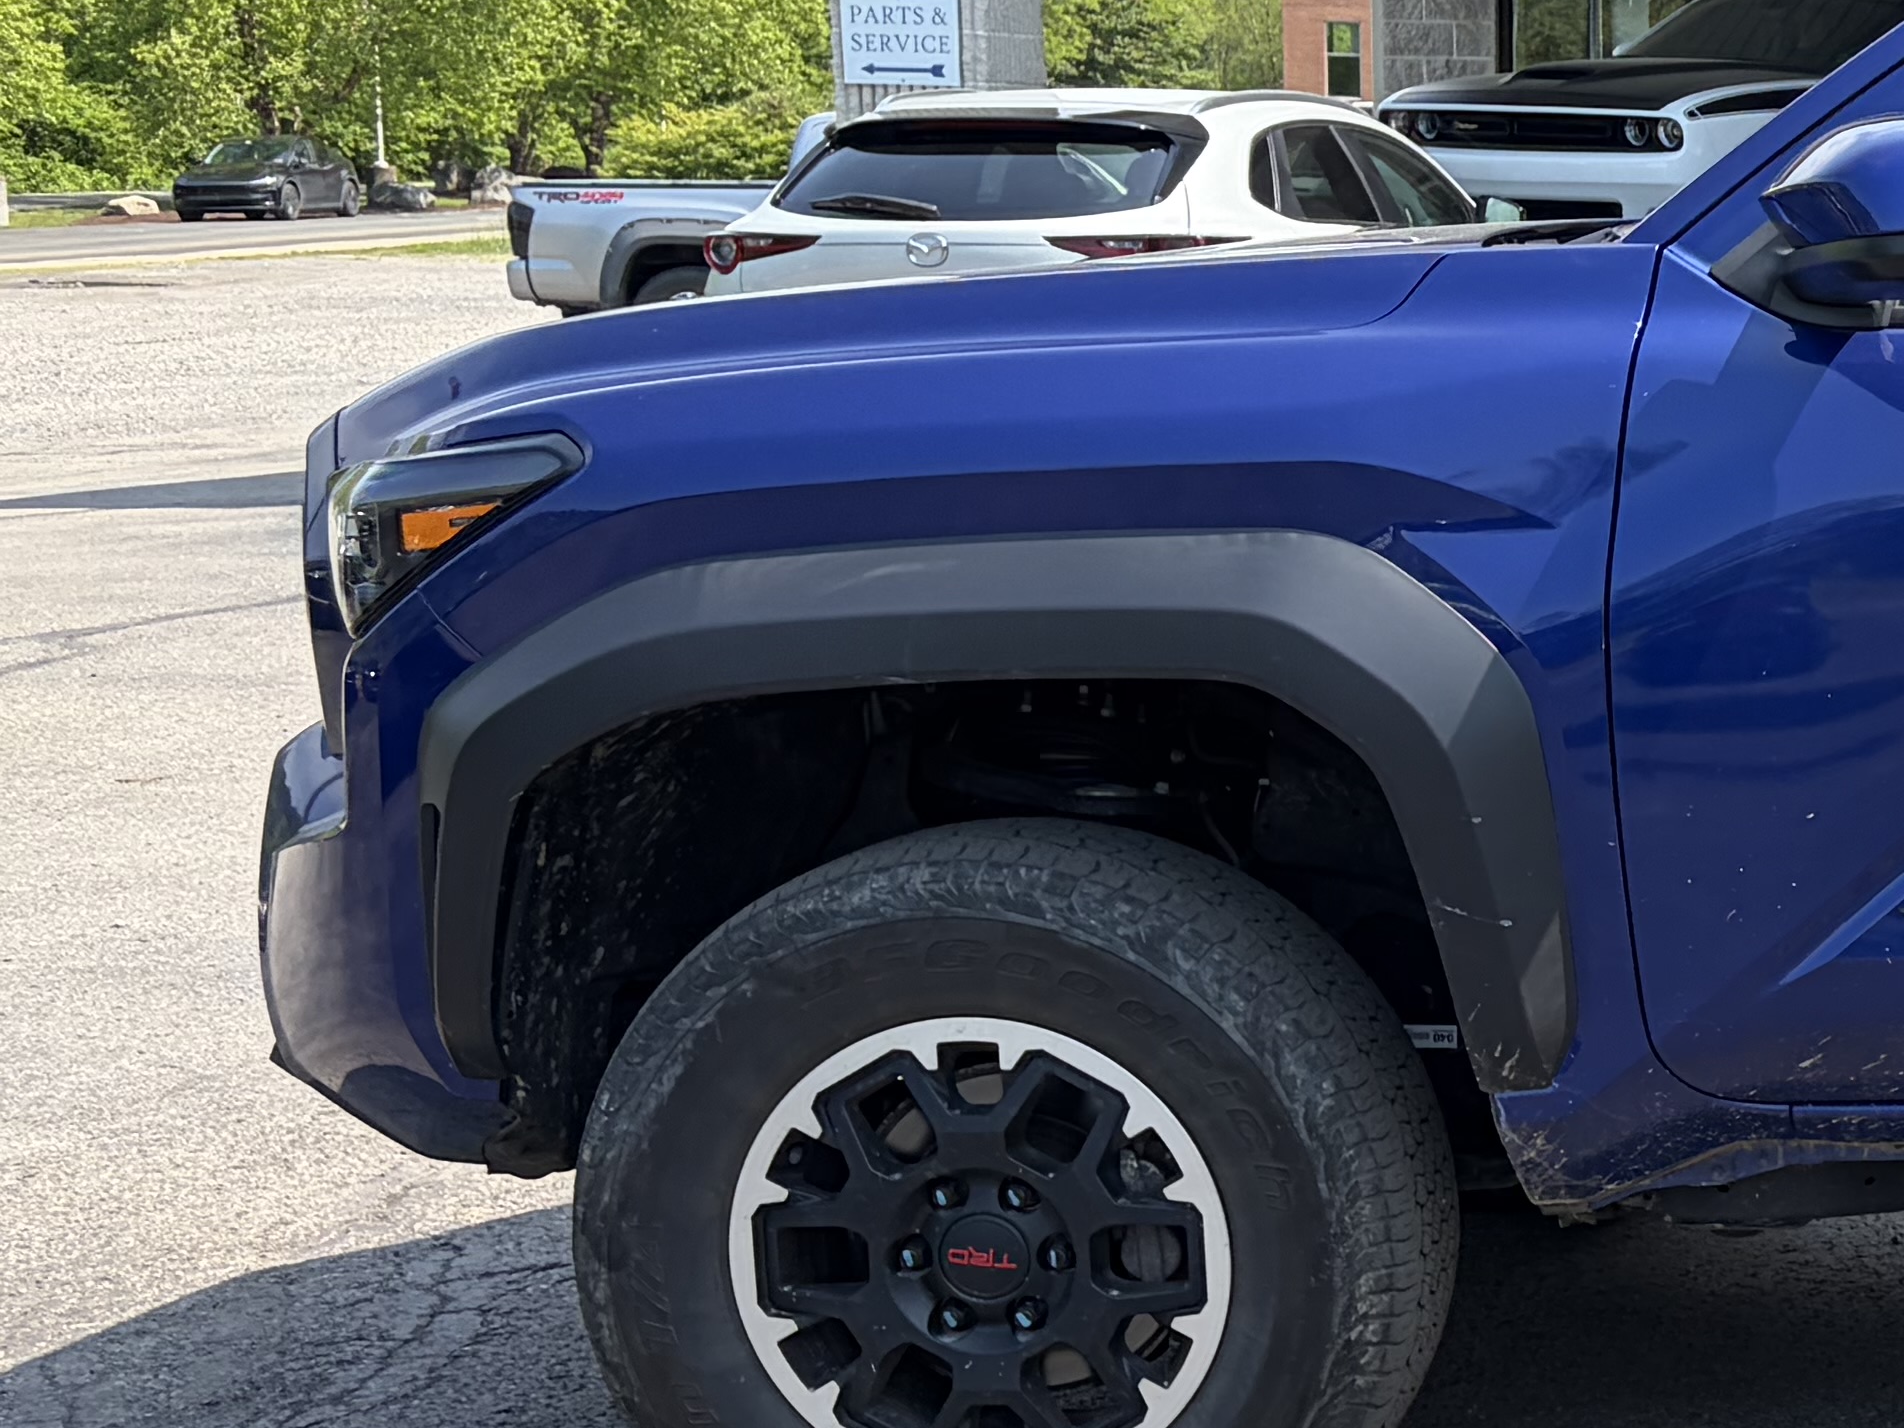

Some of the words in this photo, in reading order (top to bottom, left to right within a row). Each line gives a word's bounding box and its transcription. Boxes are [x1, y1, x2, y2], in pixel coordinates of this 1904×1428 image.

[850, 4, 925, 26] PARTS
[931, 6, 948, 26] &
[850, 32, 951, 54] SERVICE
[947, 1246, 1018, 1270] TRD
